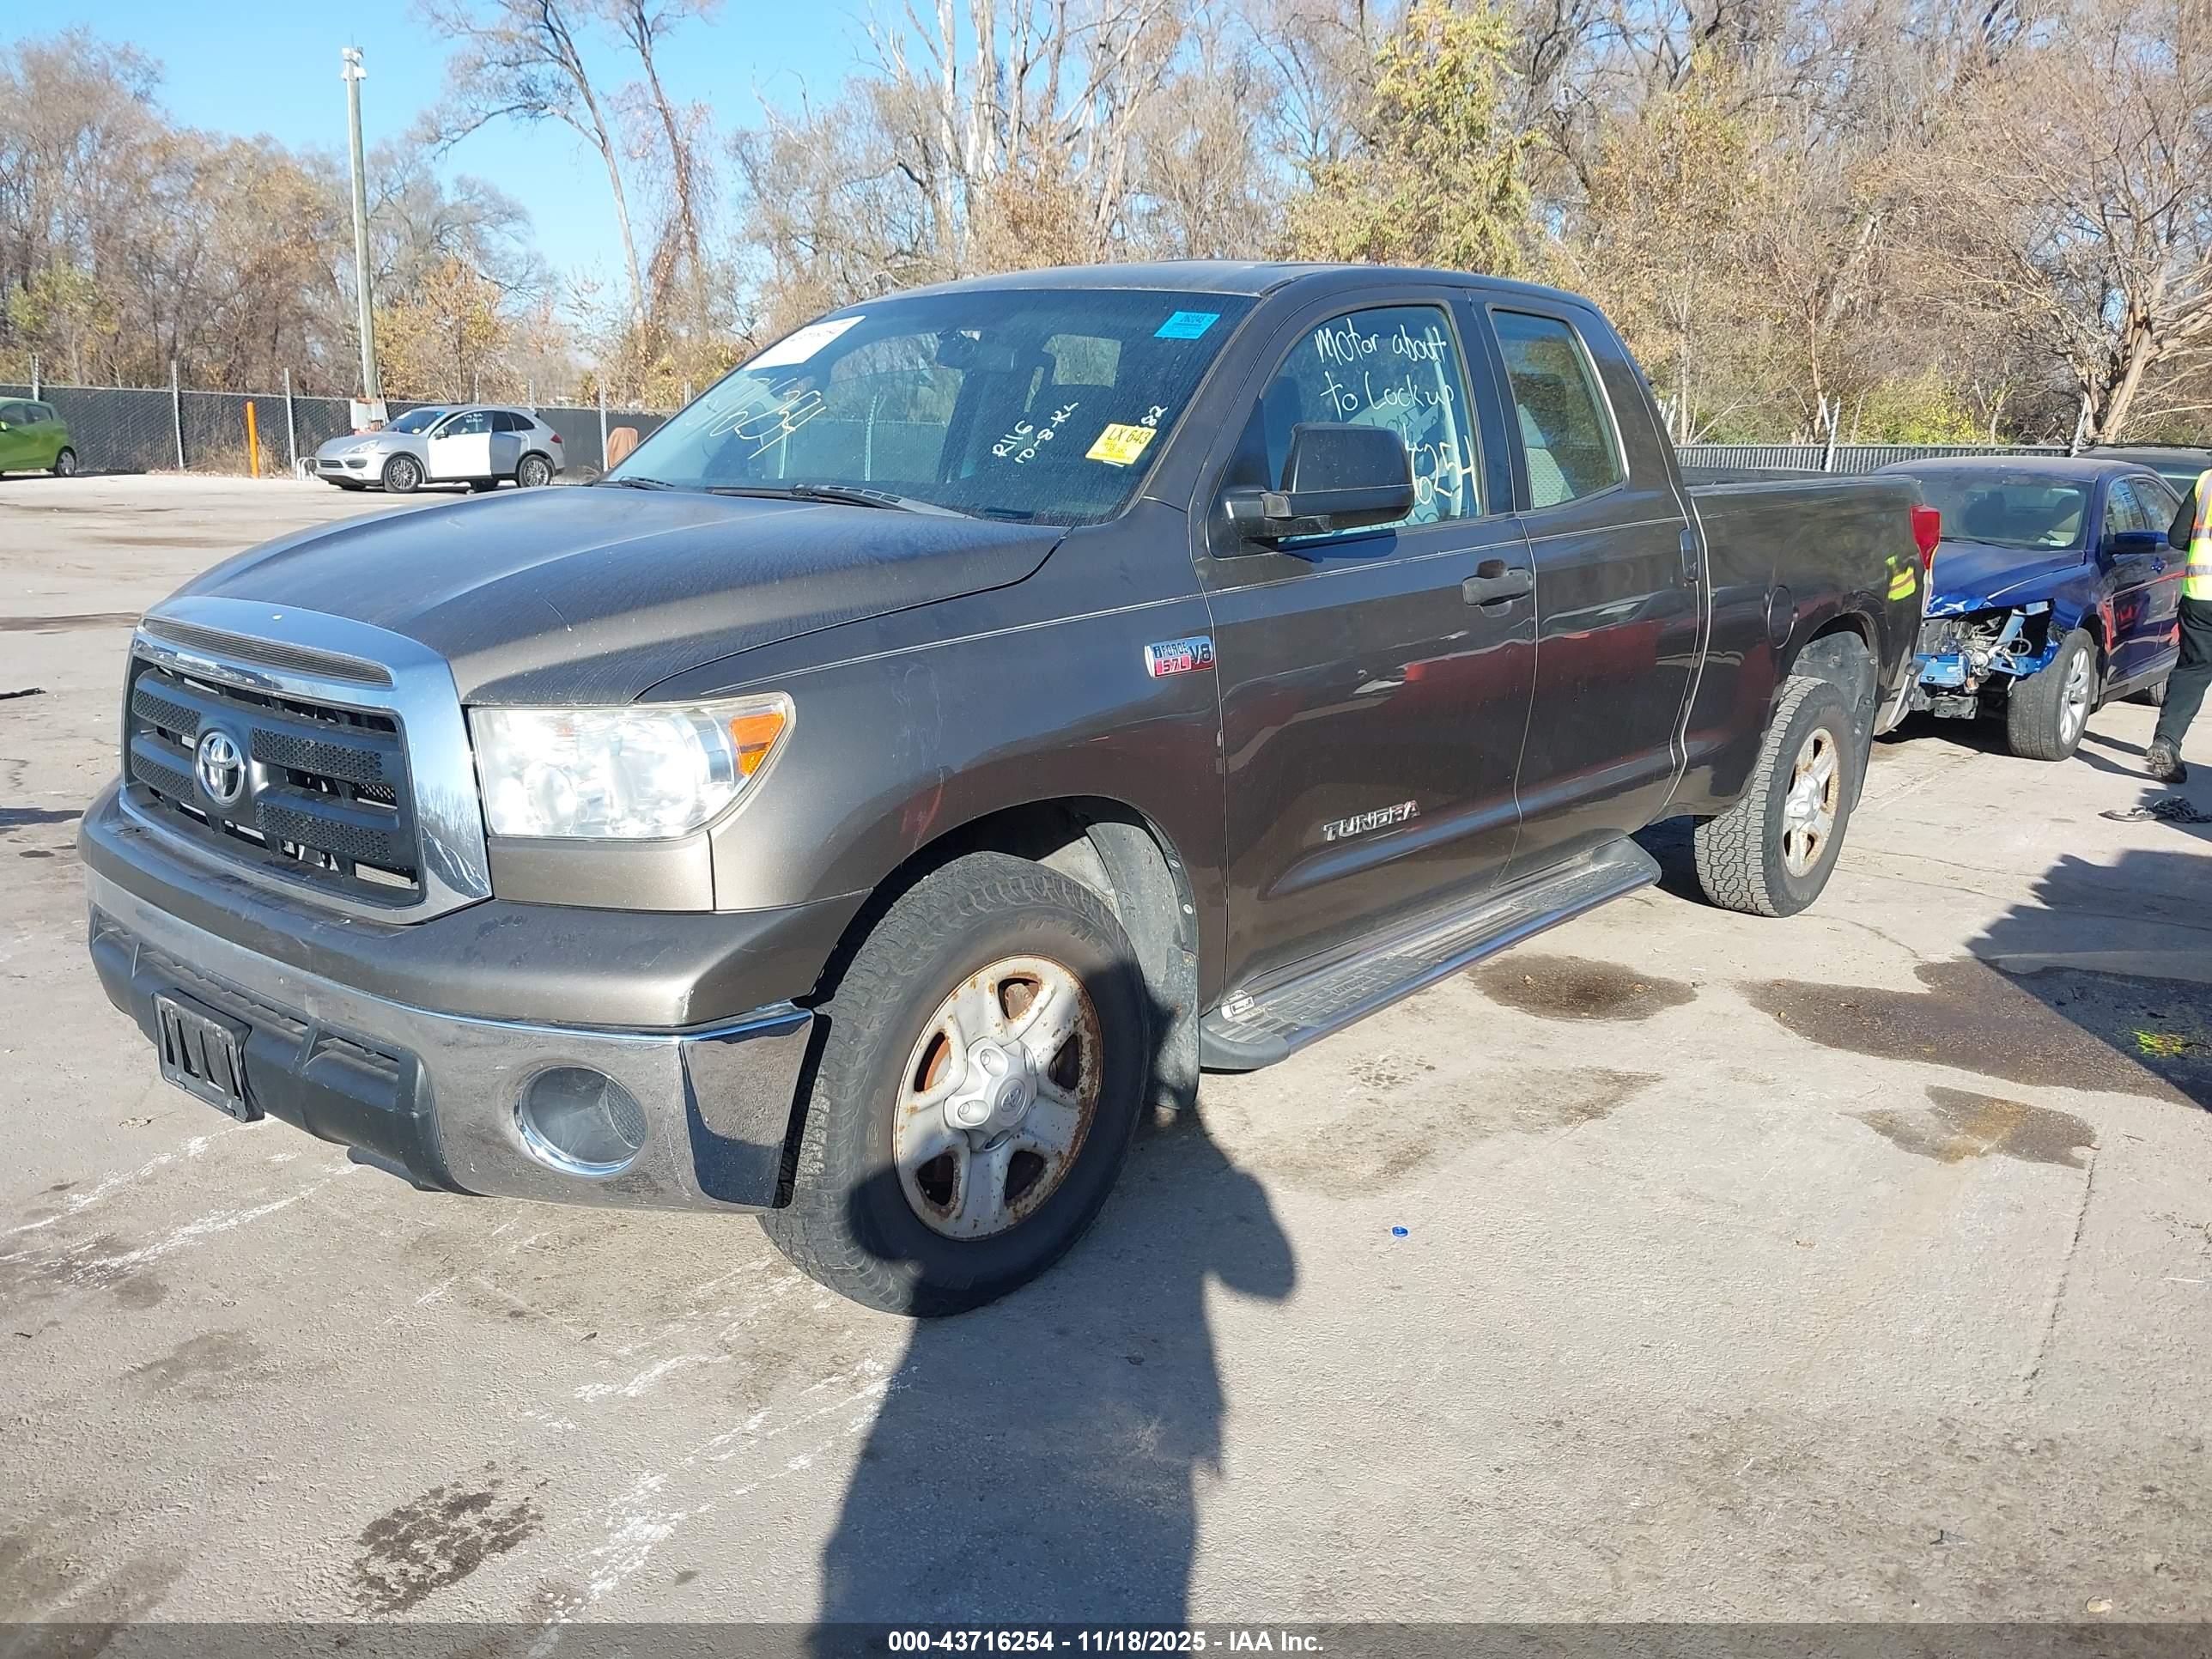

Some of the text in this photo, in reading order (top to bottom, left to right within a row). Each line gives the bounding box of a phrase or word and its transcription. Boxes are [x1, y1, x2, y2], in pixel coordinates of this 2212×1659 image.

[1392, 324, 1447, 364] about
[1126, 429, 1152, 445] 643
[1190, 642, 1212, 664] V8
[1322, 799, 1421, 842] TUNDRA
